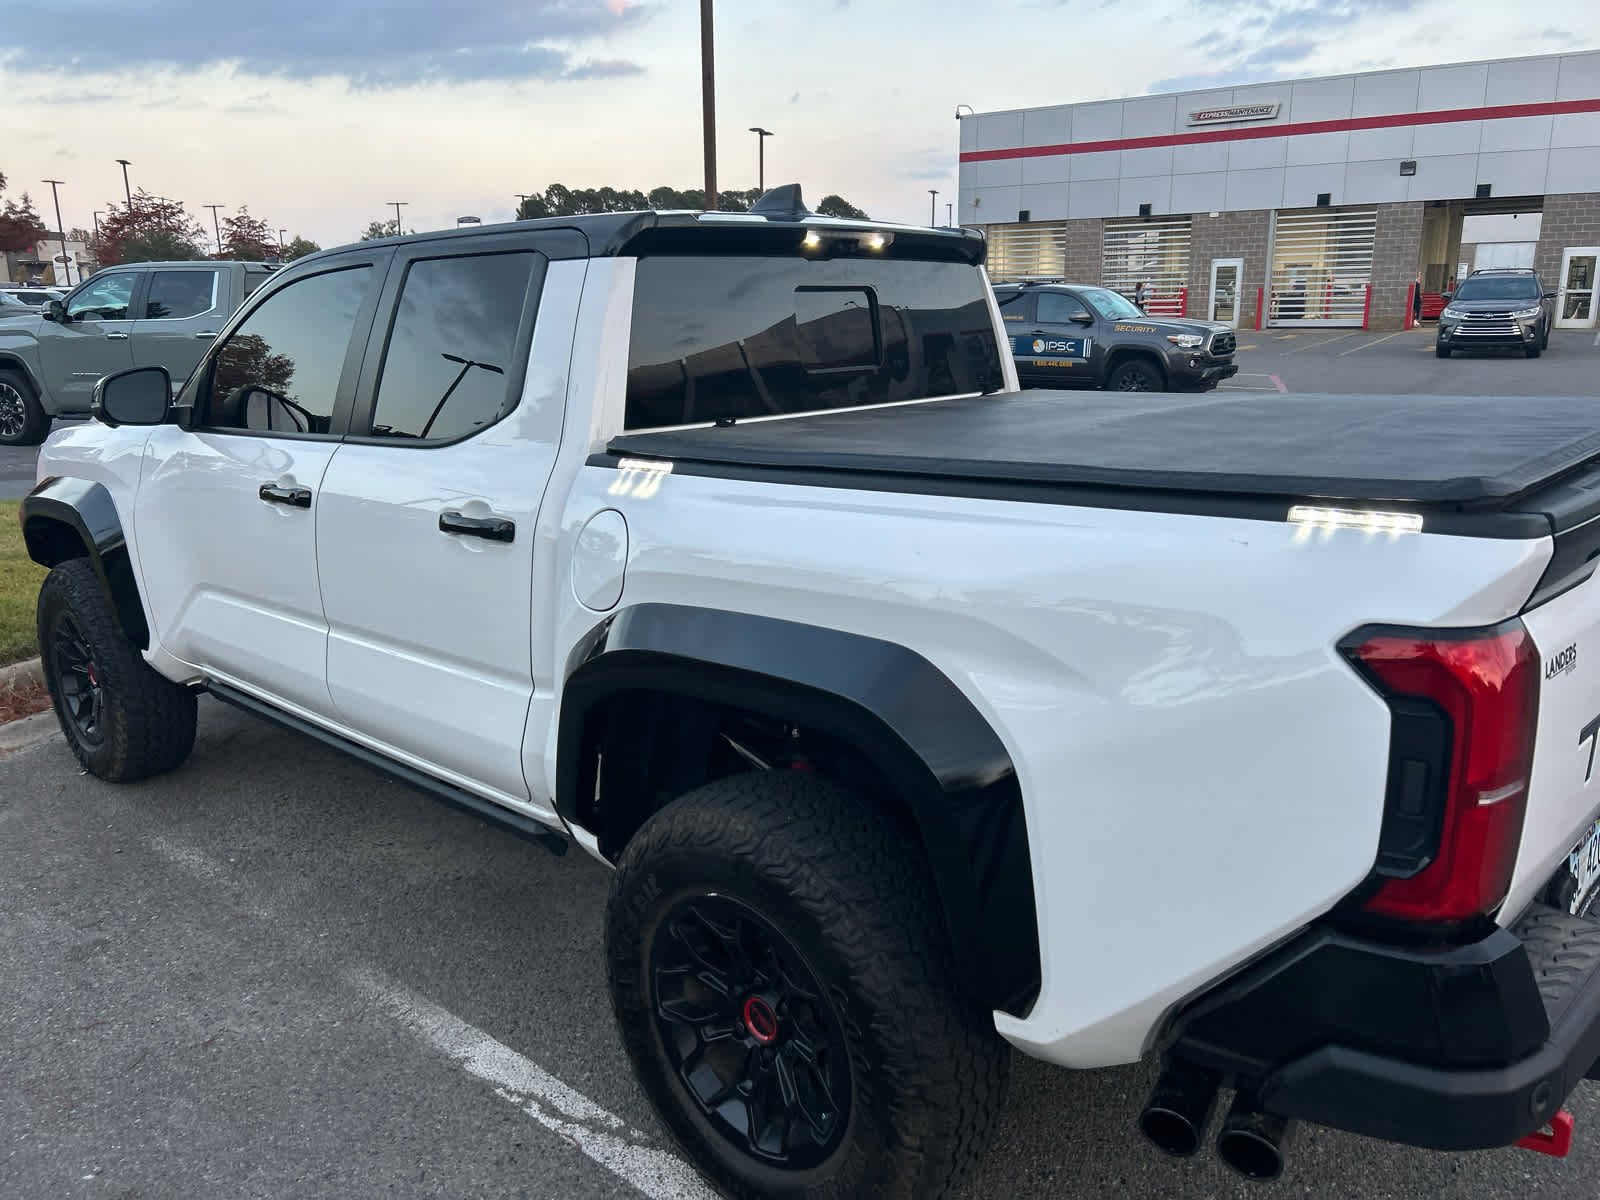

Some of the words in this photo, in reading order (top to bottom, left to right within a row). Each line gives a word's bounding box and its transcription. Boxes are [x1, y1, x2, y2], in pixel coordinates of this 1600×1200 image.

[1114, 324, 1157, 333] SECURITY
[1045, 341, 1076, 351] IPSC
[1545, 643, 1577, 680] LANDERS
